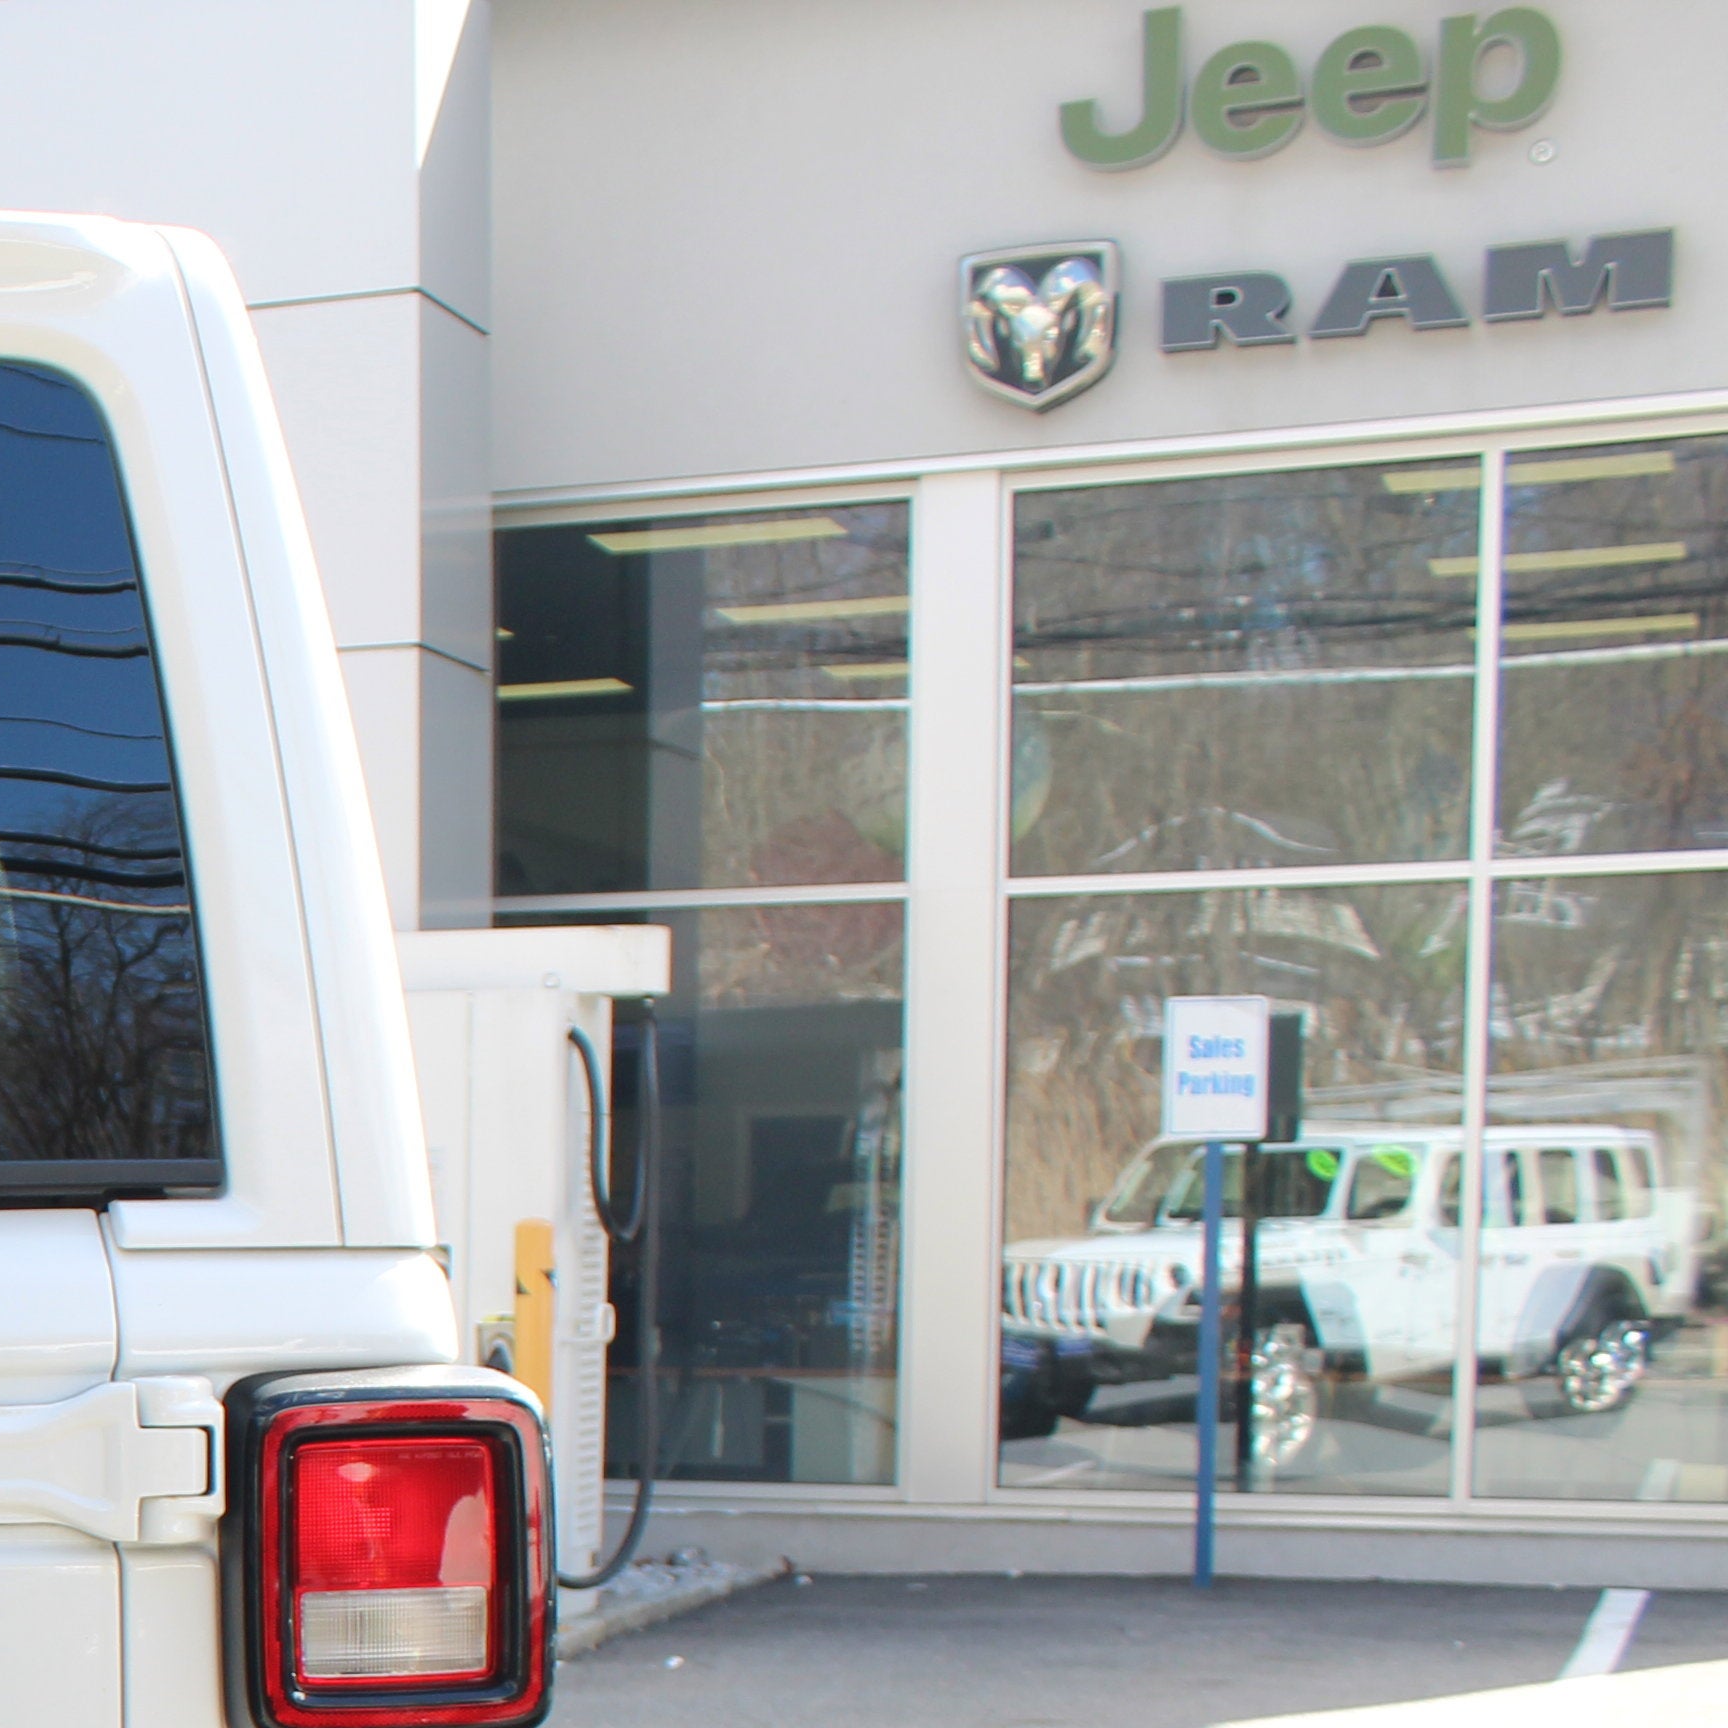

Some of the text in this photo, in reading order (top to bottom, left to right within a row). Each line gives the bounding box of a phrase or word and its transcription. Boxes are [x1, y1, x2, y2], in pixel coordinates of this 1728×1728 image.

[1059, 5, 1563, 170] Jeep
[1159, 228, 1675, 353] RAM
[1177, 1071, 1257, 1097] Parking
[1189, 1034, 1246, 1059] Sales
